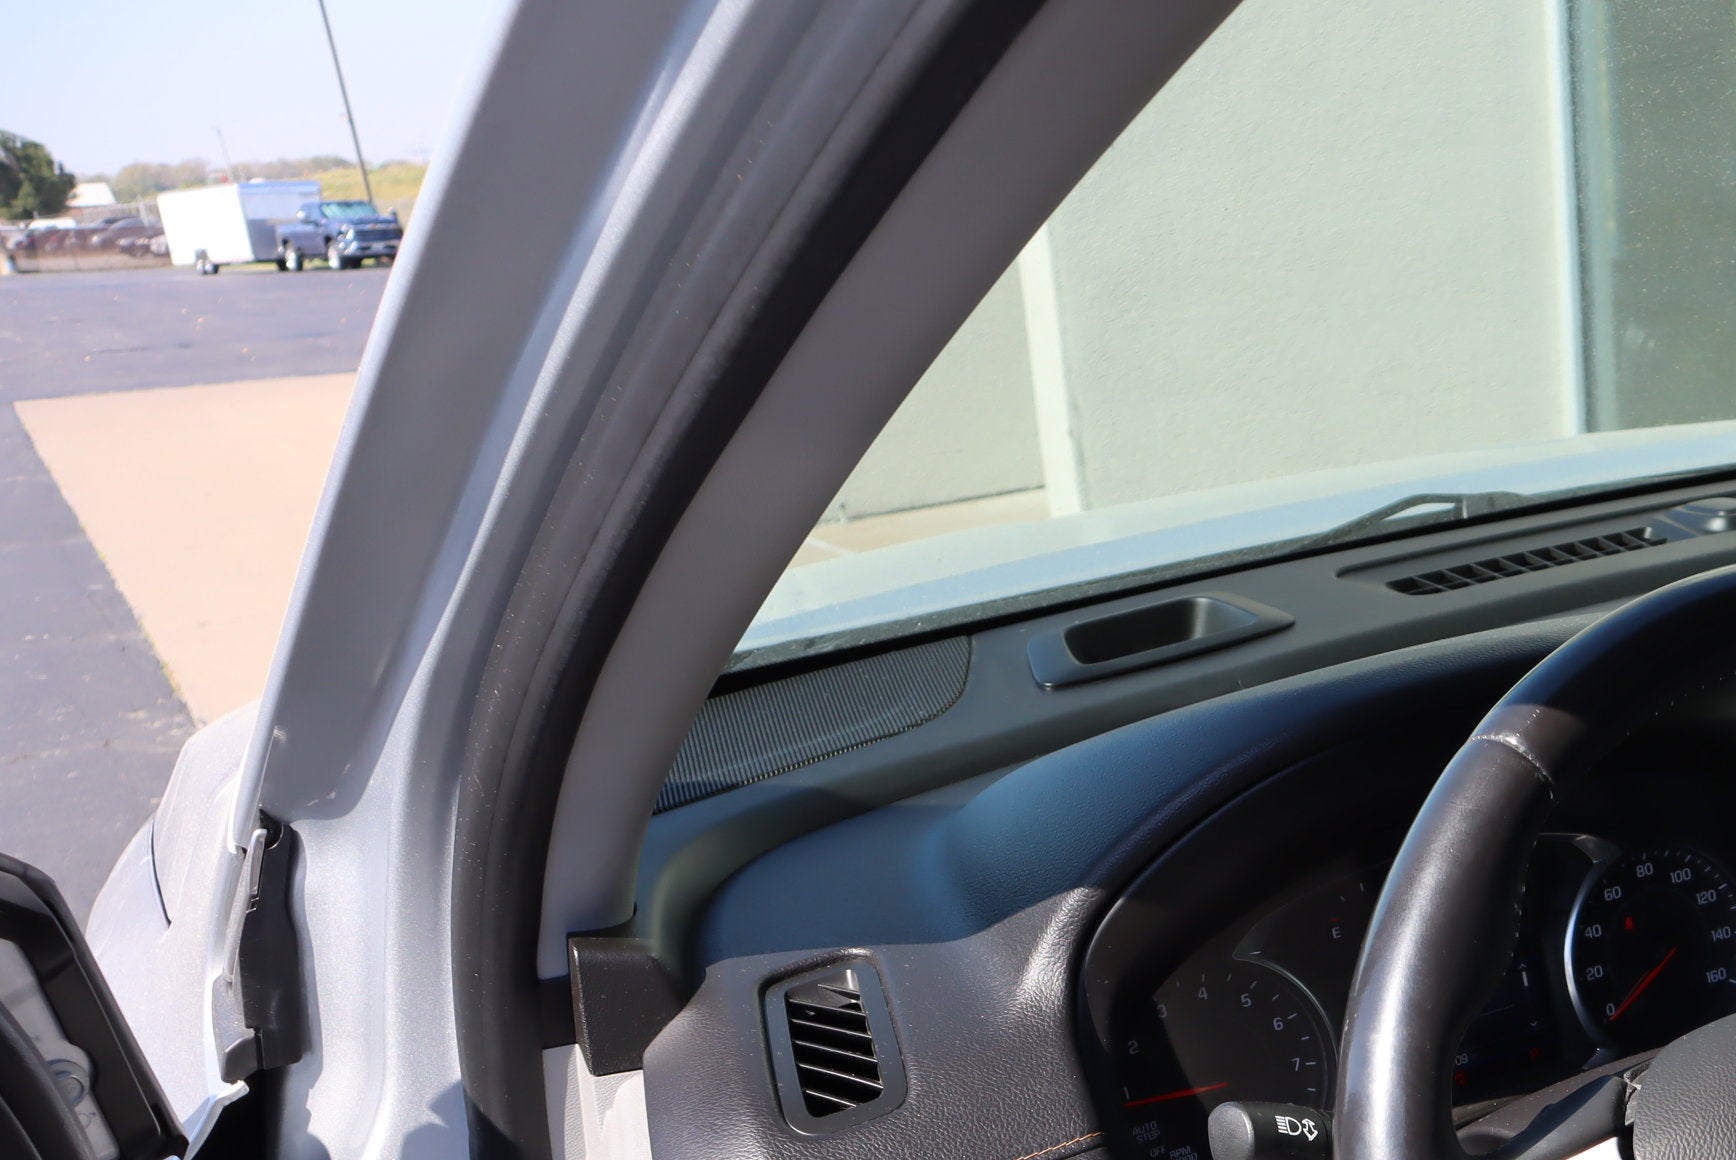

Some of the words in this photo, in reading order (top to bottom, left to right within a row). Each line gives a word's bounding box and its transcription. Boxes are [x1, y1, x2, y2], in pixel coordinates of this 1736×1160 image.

[1636, 862, 1653, 878] 80
[1670, 867, 1692, 884] 100
[1604, 885, 1622, 901] 60
[1695, 889, 1717, 905] 120
[1331, 926, 1342, 940] E
[1585, 923, 1602, 939] 40
[1711, 926, 1731, 942] 140
[1586, 965, 1603, 981] 20
[1705, 967, 1727, 984] 160
[1198, 987, 1209, 1001] 4
[1240, 993, 1252, 1008] 5
[1157, 1004, 1167, 1019] 3
[1606, 1003, 1616, 1017] 0
[1273, 1017, 1284, 1031] 6
[1128, 1040, 1139, 1055] 2
[1291, 1057, 1300, 1072] 7
[1123, 1086, 1131, 1100] 1
[1132, 1120, 1158, 1136] AUTO
[1136, 1128, 1161, 1144] STOP
[1149, 1144, 1167, 1158] OFF
[1169, 1145, 1192, 1160] RPM
